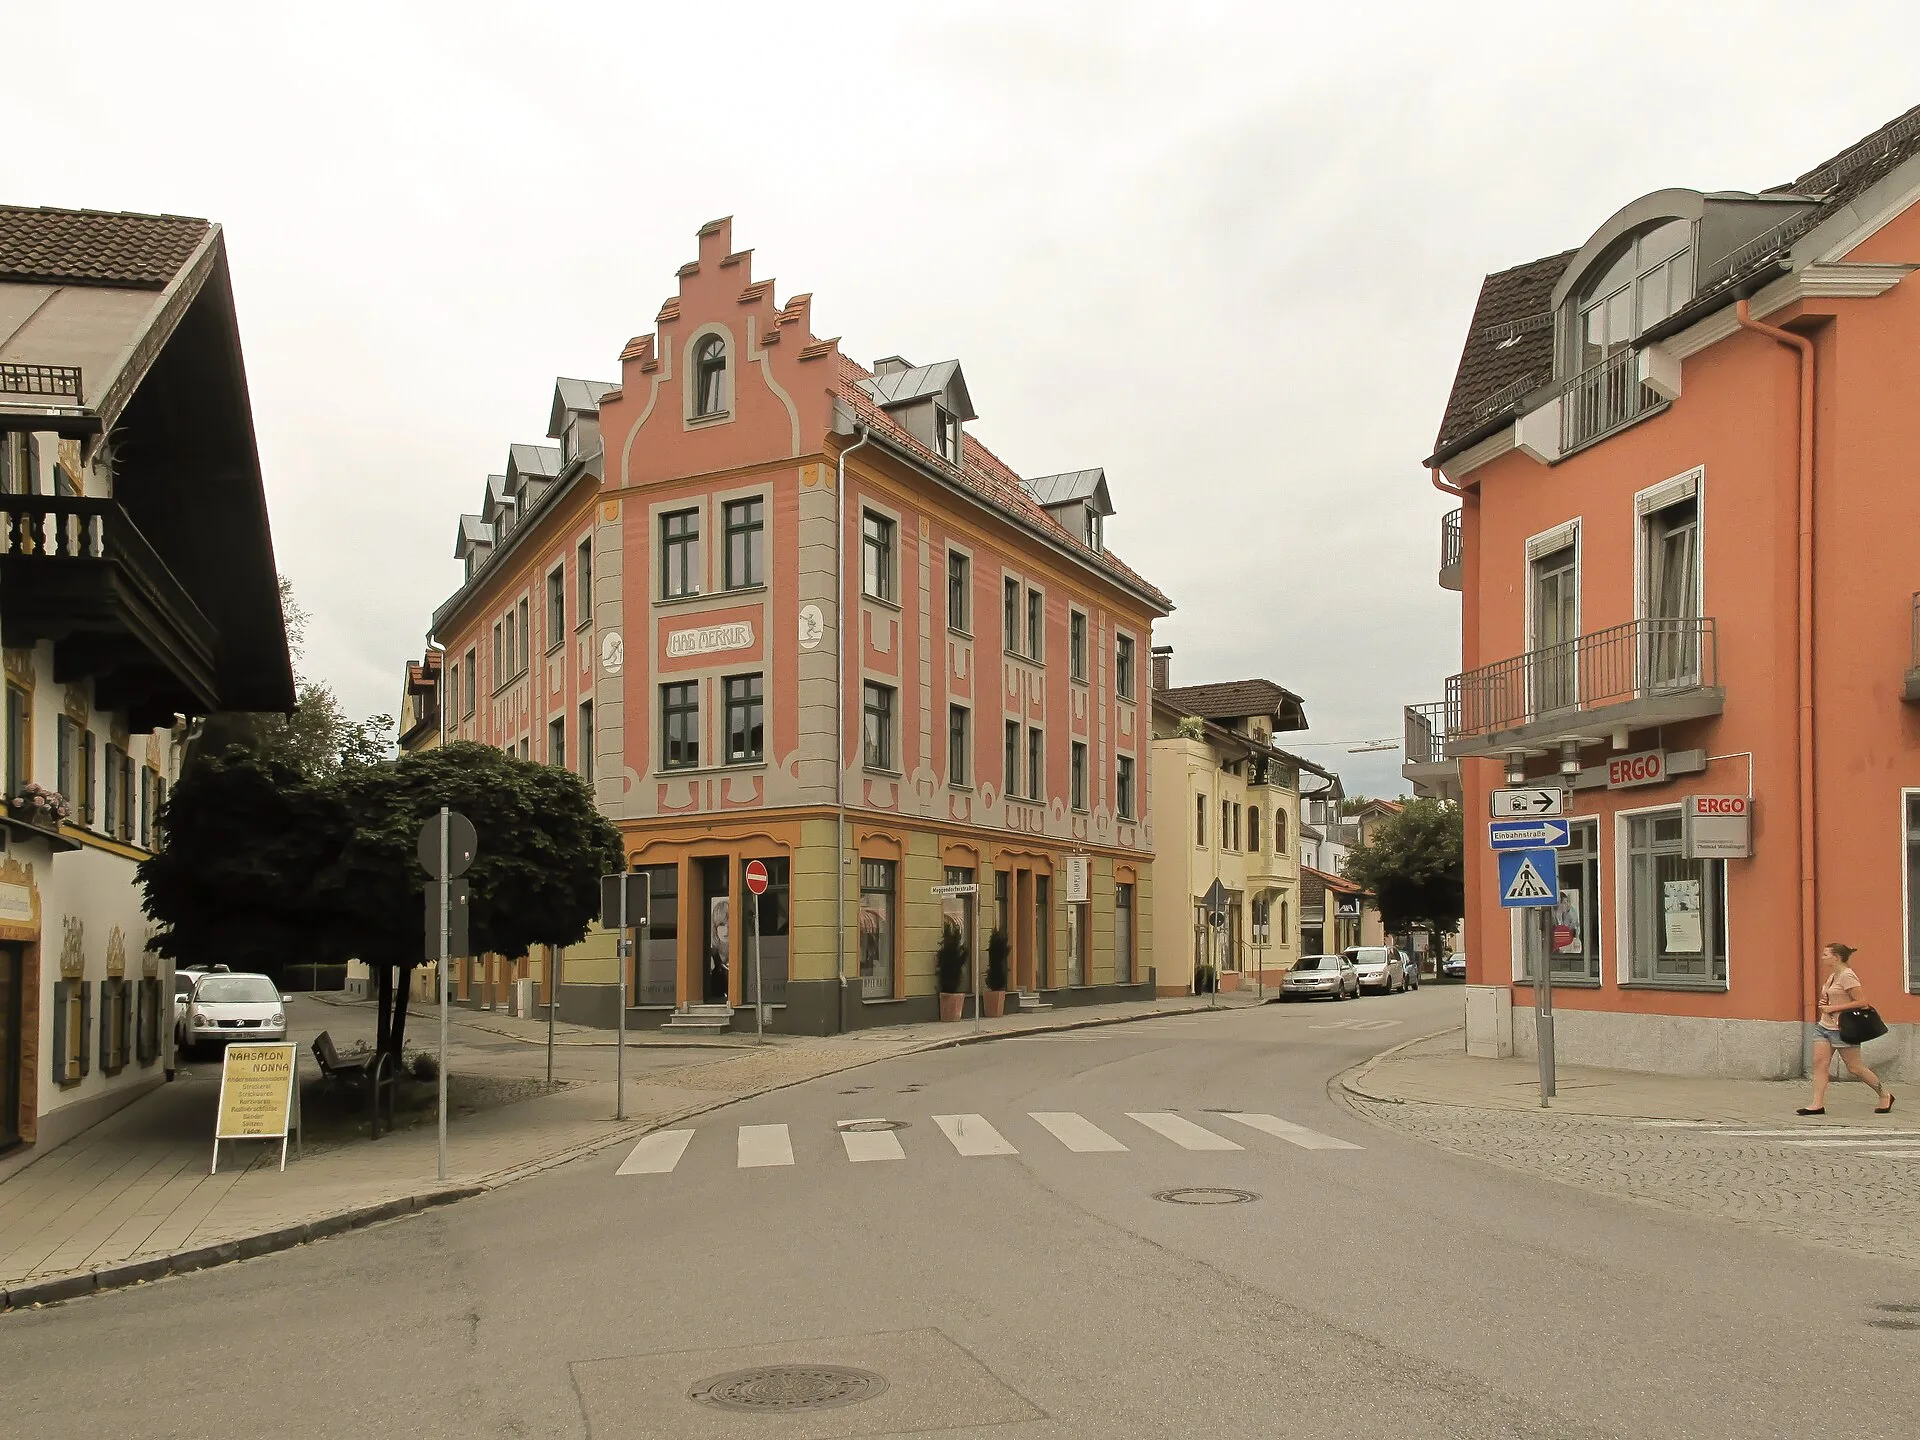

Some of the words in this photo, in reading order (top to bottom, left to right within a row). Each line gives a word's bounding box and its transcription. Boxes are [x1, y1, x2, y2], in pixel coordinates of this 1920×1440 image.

[699, 627, 747, 649] MERKUR
[1609, 754, 1661, 785] ERGO
[1697, 798, 1745, 813] ERGO
[1494, 830, 1546, 840] Einbahnstraße
[1338, 904, 1354, 912] AXA
[252, 1063, 289, 1073] NONNA
